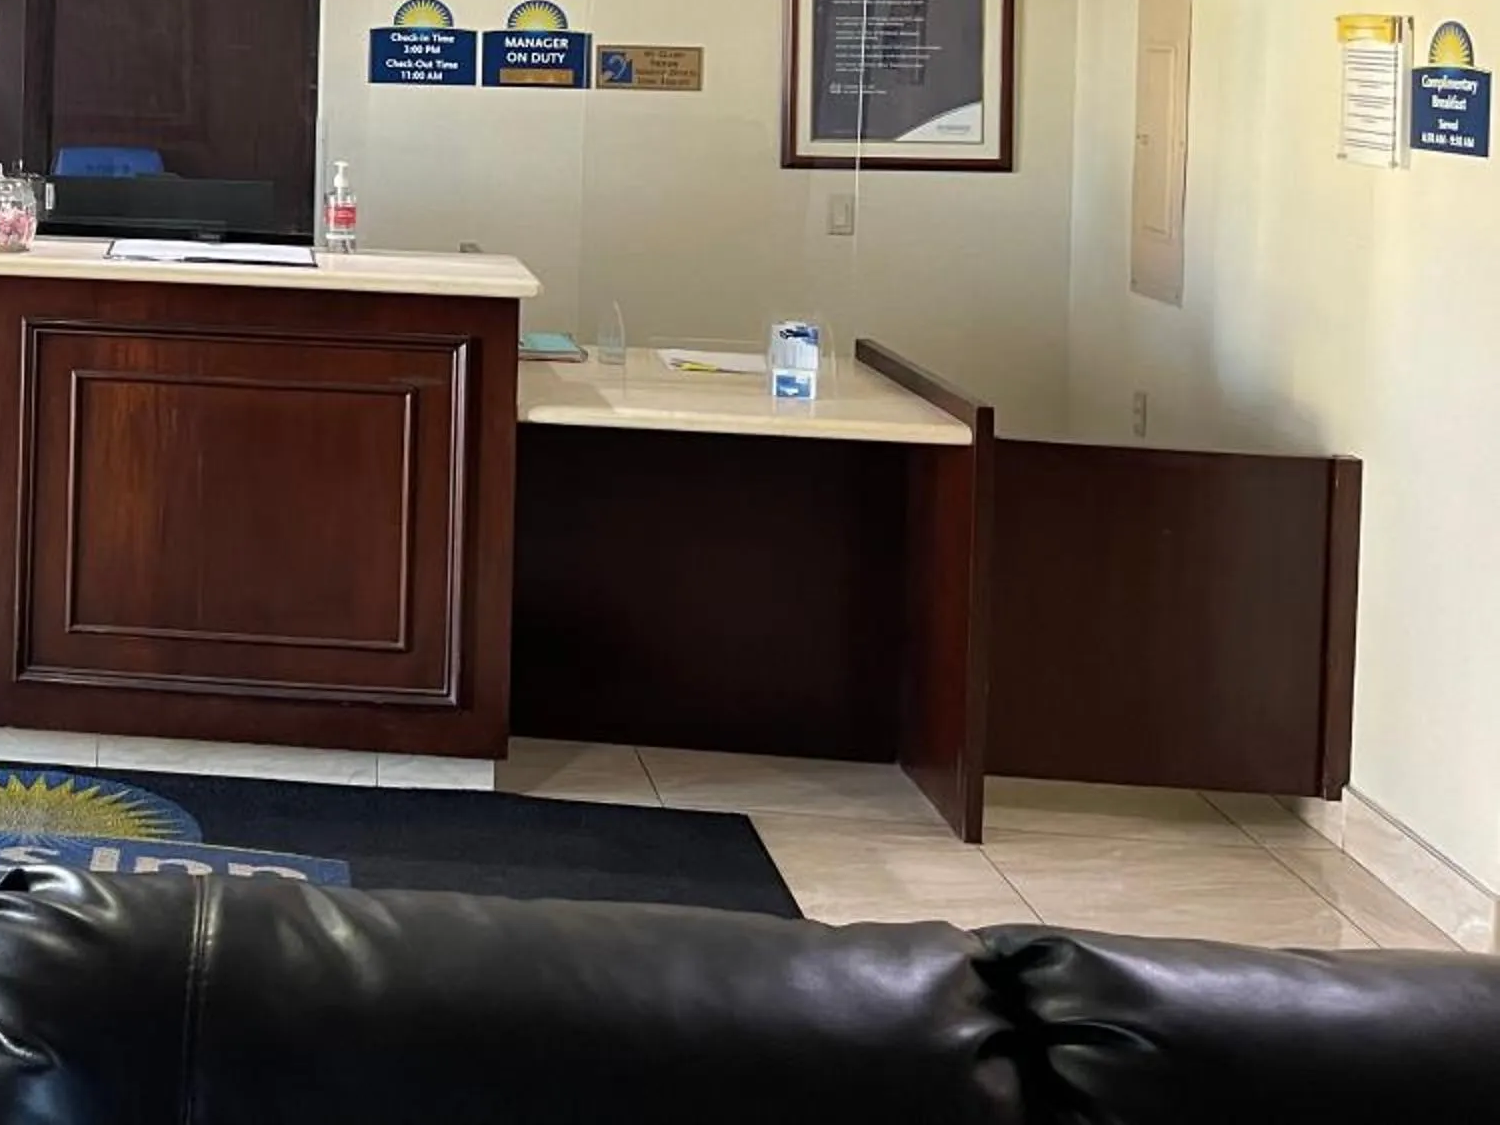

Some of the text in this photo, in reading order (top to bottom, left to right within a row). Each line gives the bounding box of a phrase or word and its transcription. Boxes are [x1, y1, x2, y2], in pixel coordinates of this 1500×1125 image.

[432, 33, 455, 44] Time
[504, 36, 569, 49] MANAGER
[425, 45, 441, 54] PM
[506, 52, 565, 64] ON DUTY
[385, 58, 459, 70] Check-Out Time
[401, 70, 443, 80] 11:00 AM
